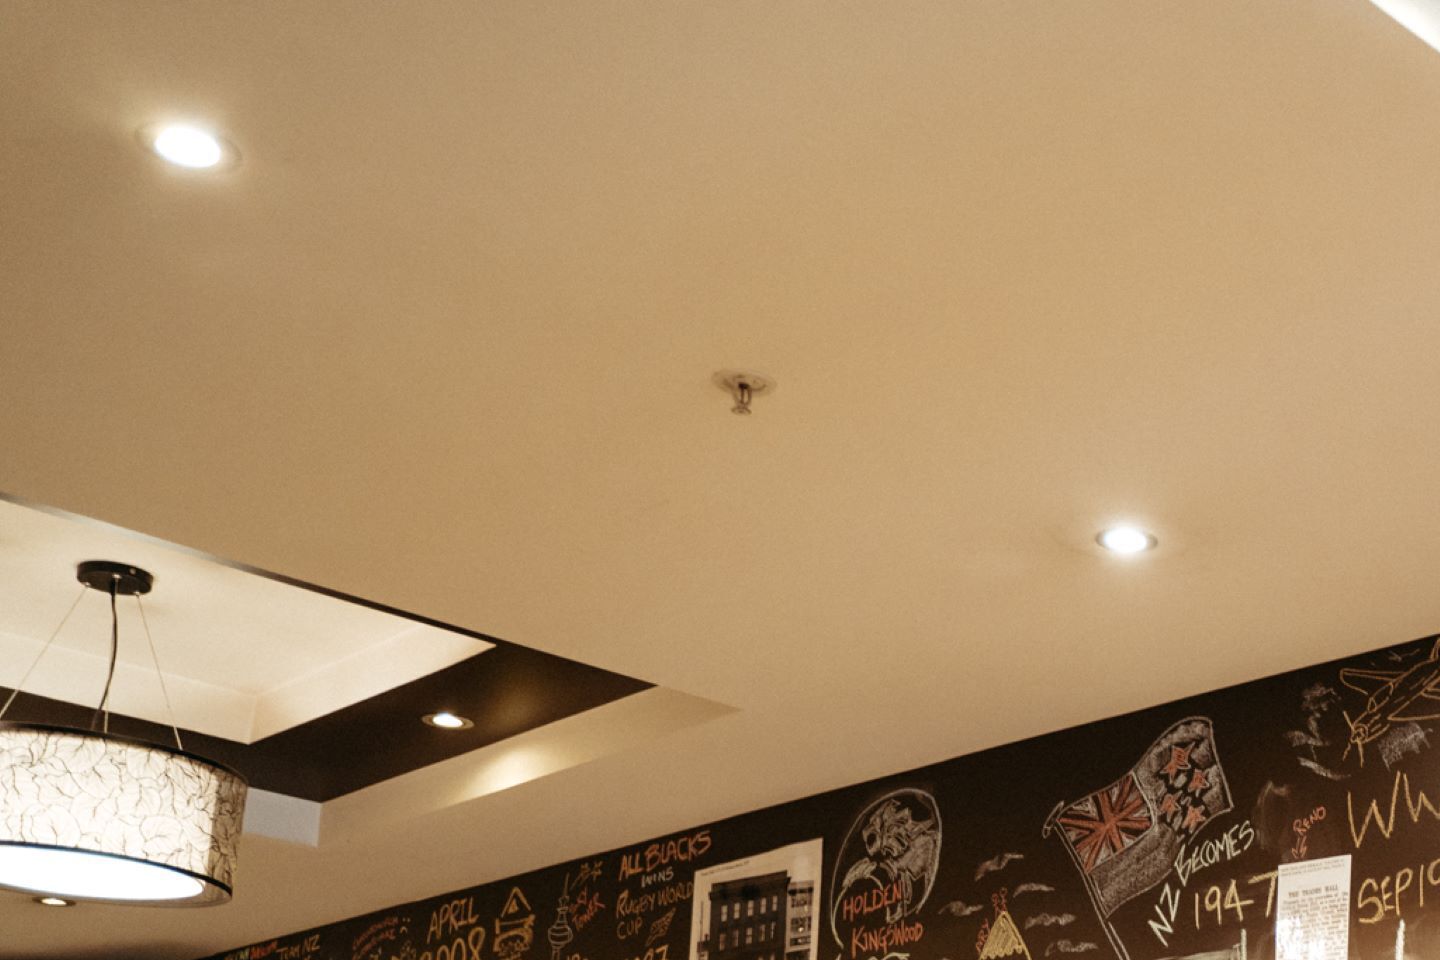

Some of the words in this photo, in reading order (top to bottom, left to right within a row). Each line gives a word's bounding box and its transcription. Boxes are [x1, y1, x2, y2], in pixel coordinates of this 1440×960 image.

[619, 851, 643, 880] ALL
[644, 830, 712, 872] BLACKS
[1174, 821, 1255, 886] BECOMES
[427, 897, 479, 944] APRIL
[843, 880, 902, 921] HOLDEN
[1358, 878, 1411, 925] SEP
[616, 918, 643, 940] CUP
[852, 920, 923, 960] KINGSWOOD
